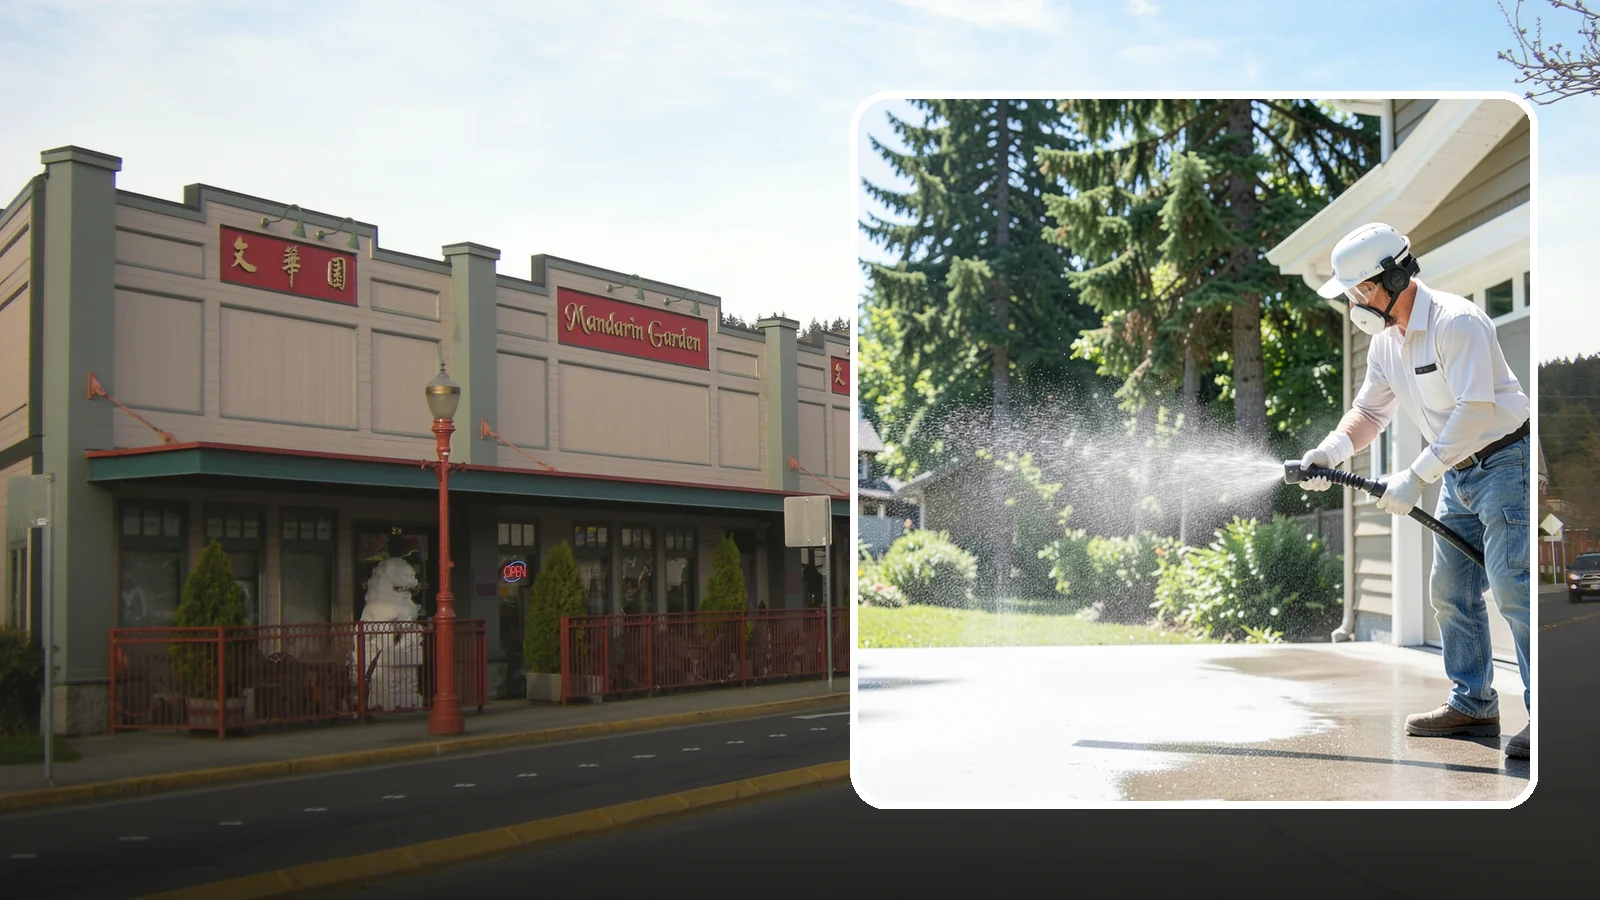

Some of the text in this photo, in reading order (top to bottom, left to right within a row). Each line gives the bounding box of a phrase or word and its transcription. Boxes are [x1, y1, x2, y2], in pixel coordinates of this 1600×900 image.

[564, 302, 702, 352] Mandarin Garden
[835, 363, 846, 386] 文
[503, 565, 527, 578] OPEN
